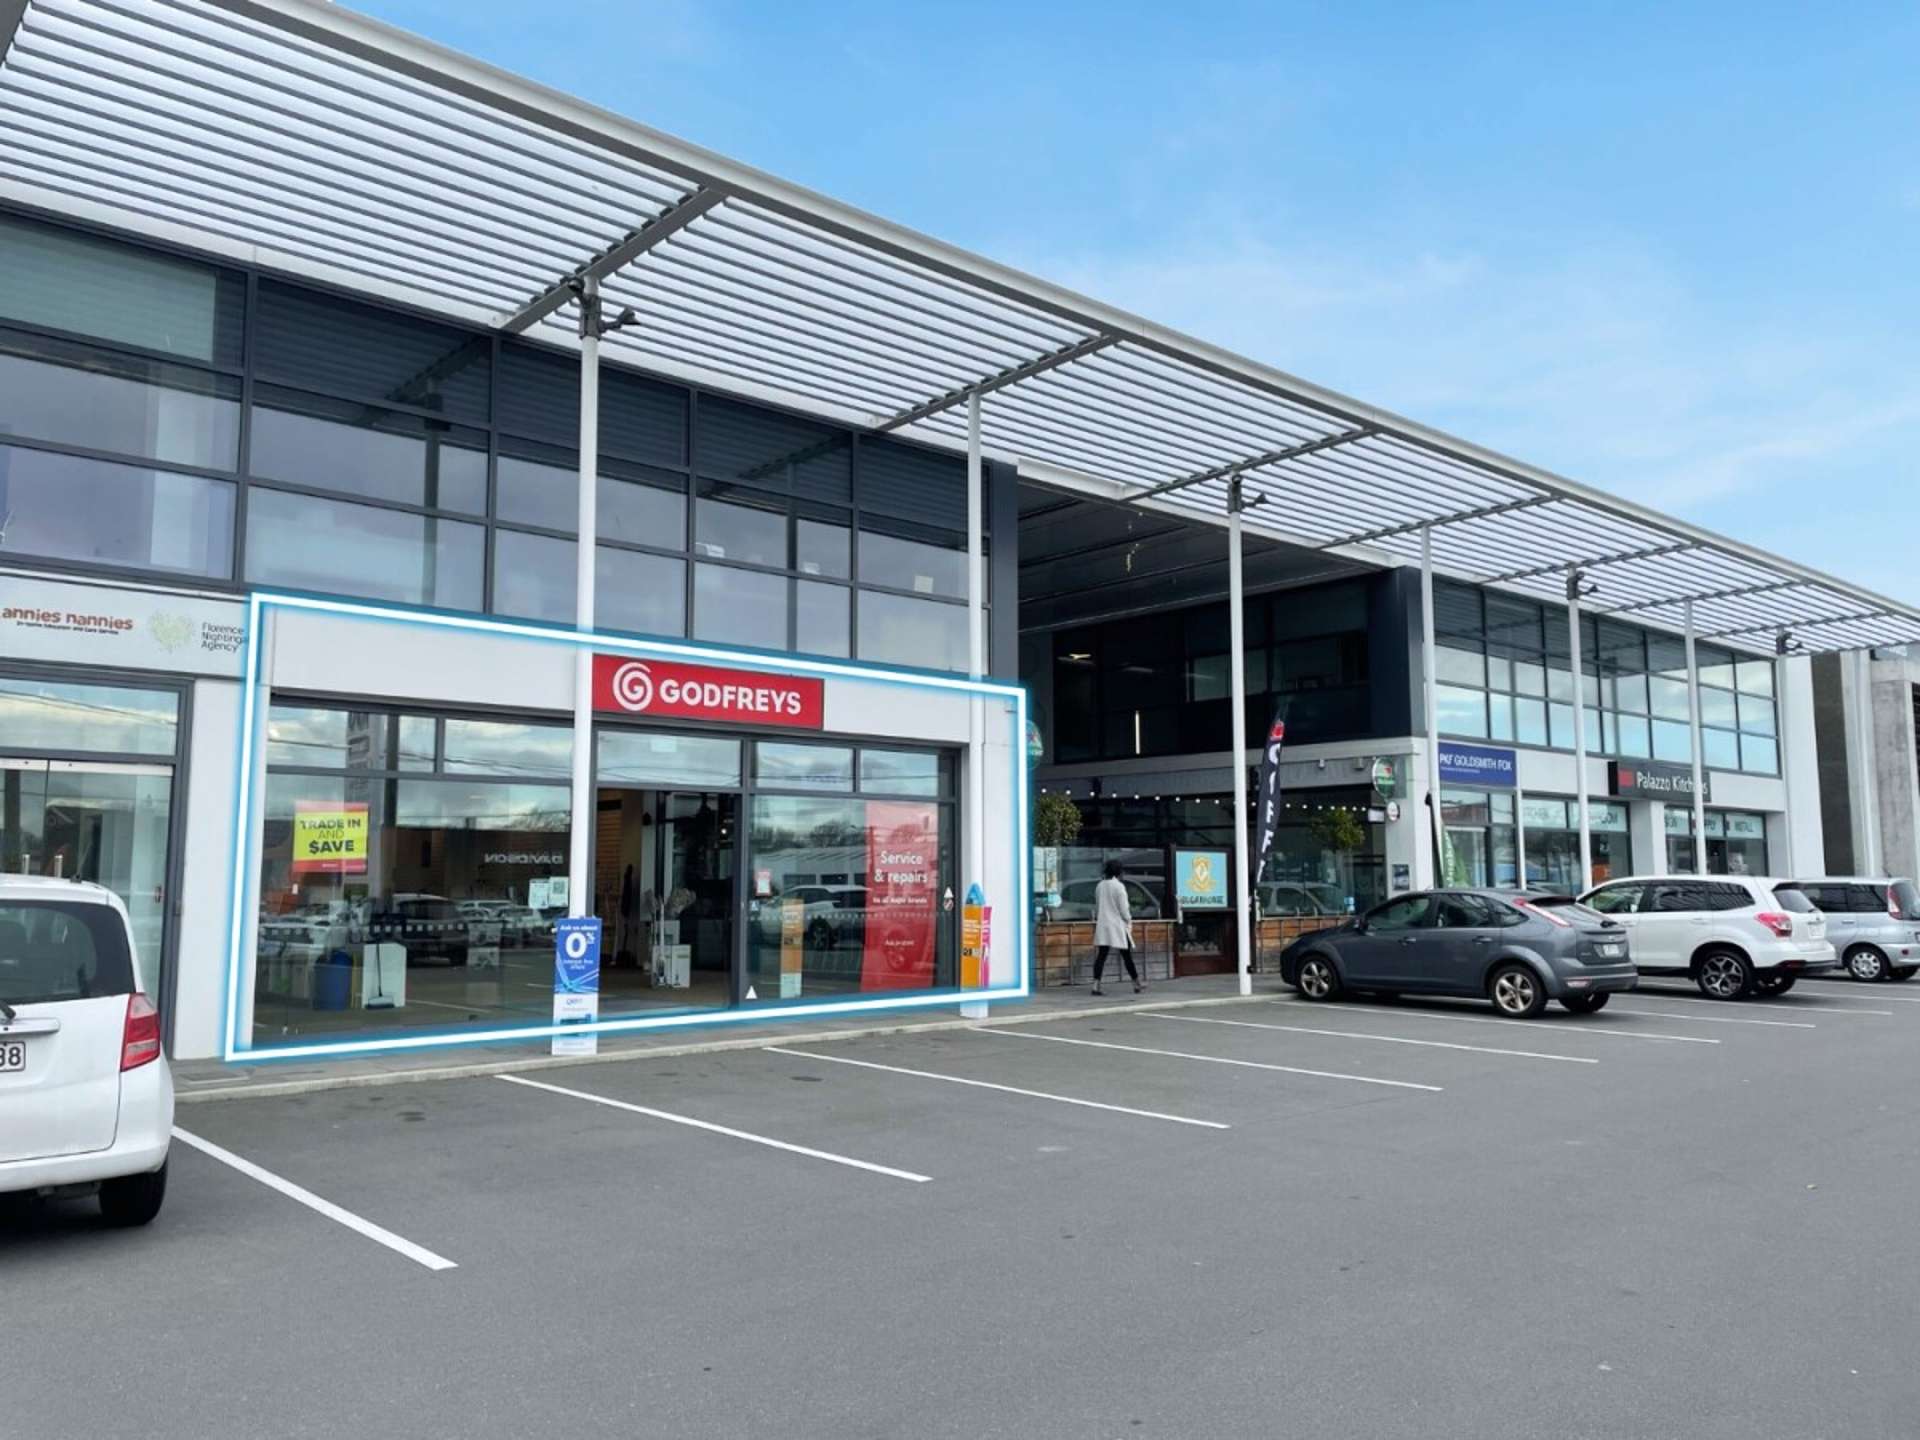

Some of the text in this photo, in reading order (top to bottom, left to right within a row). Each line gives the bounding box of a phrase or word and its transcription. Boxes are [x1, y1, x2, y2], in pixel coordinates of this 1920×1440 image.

[2, 607, 133, 630] annies nannies
[202, 622, 244, 634] Florence
[201, 631, 247, 645] Nighting
[201, 640, 238, 653] Agency
[660, 678, 801, 715] GODFREYS
[1440, 753, 1453, 765] PKF
[1454, 754, 1496, 769] GOLDSMITH
[1636, 771, 1708, 795] Palazzo Kitchs
[300, 818, 361, 830] TRADE IN
[318, 829, 345, 840] AND
[308, 839, 354, 855] $AVE
[881, 850, 923, 865] Service
[874, 869, 928, 885] & repairs
